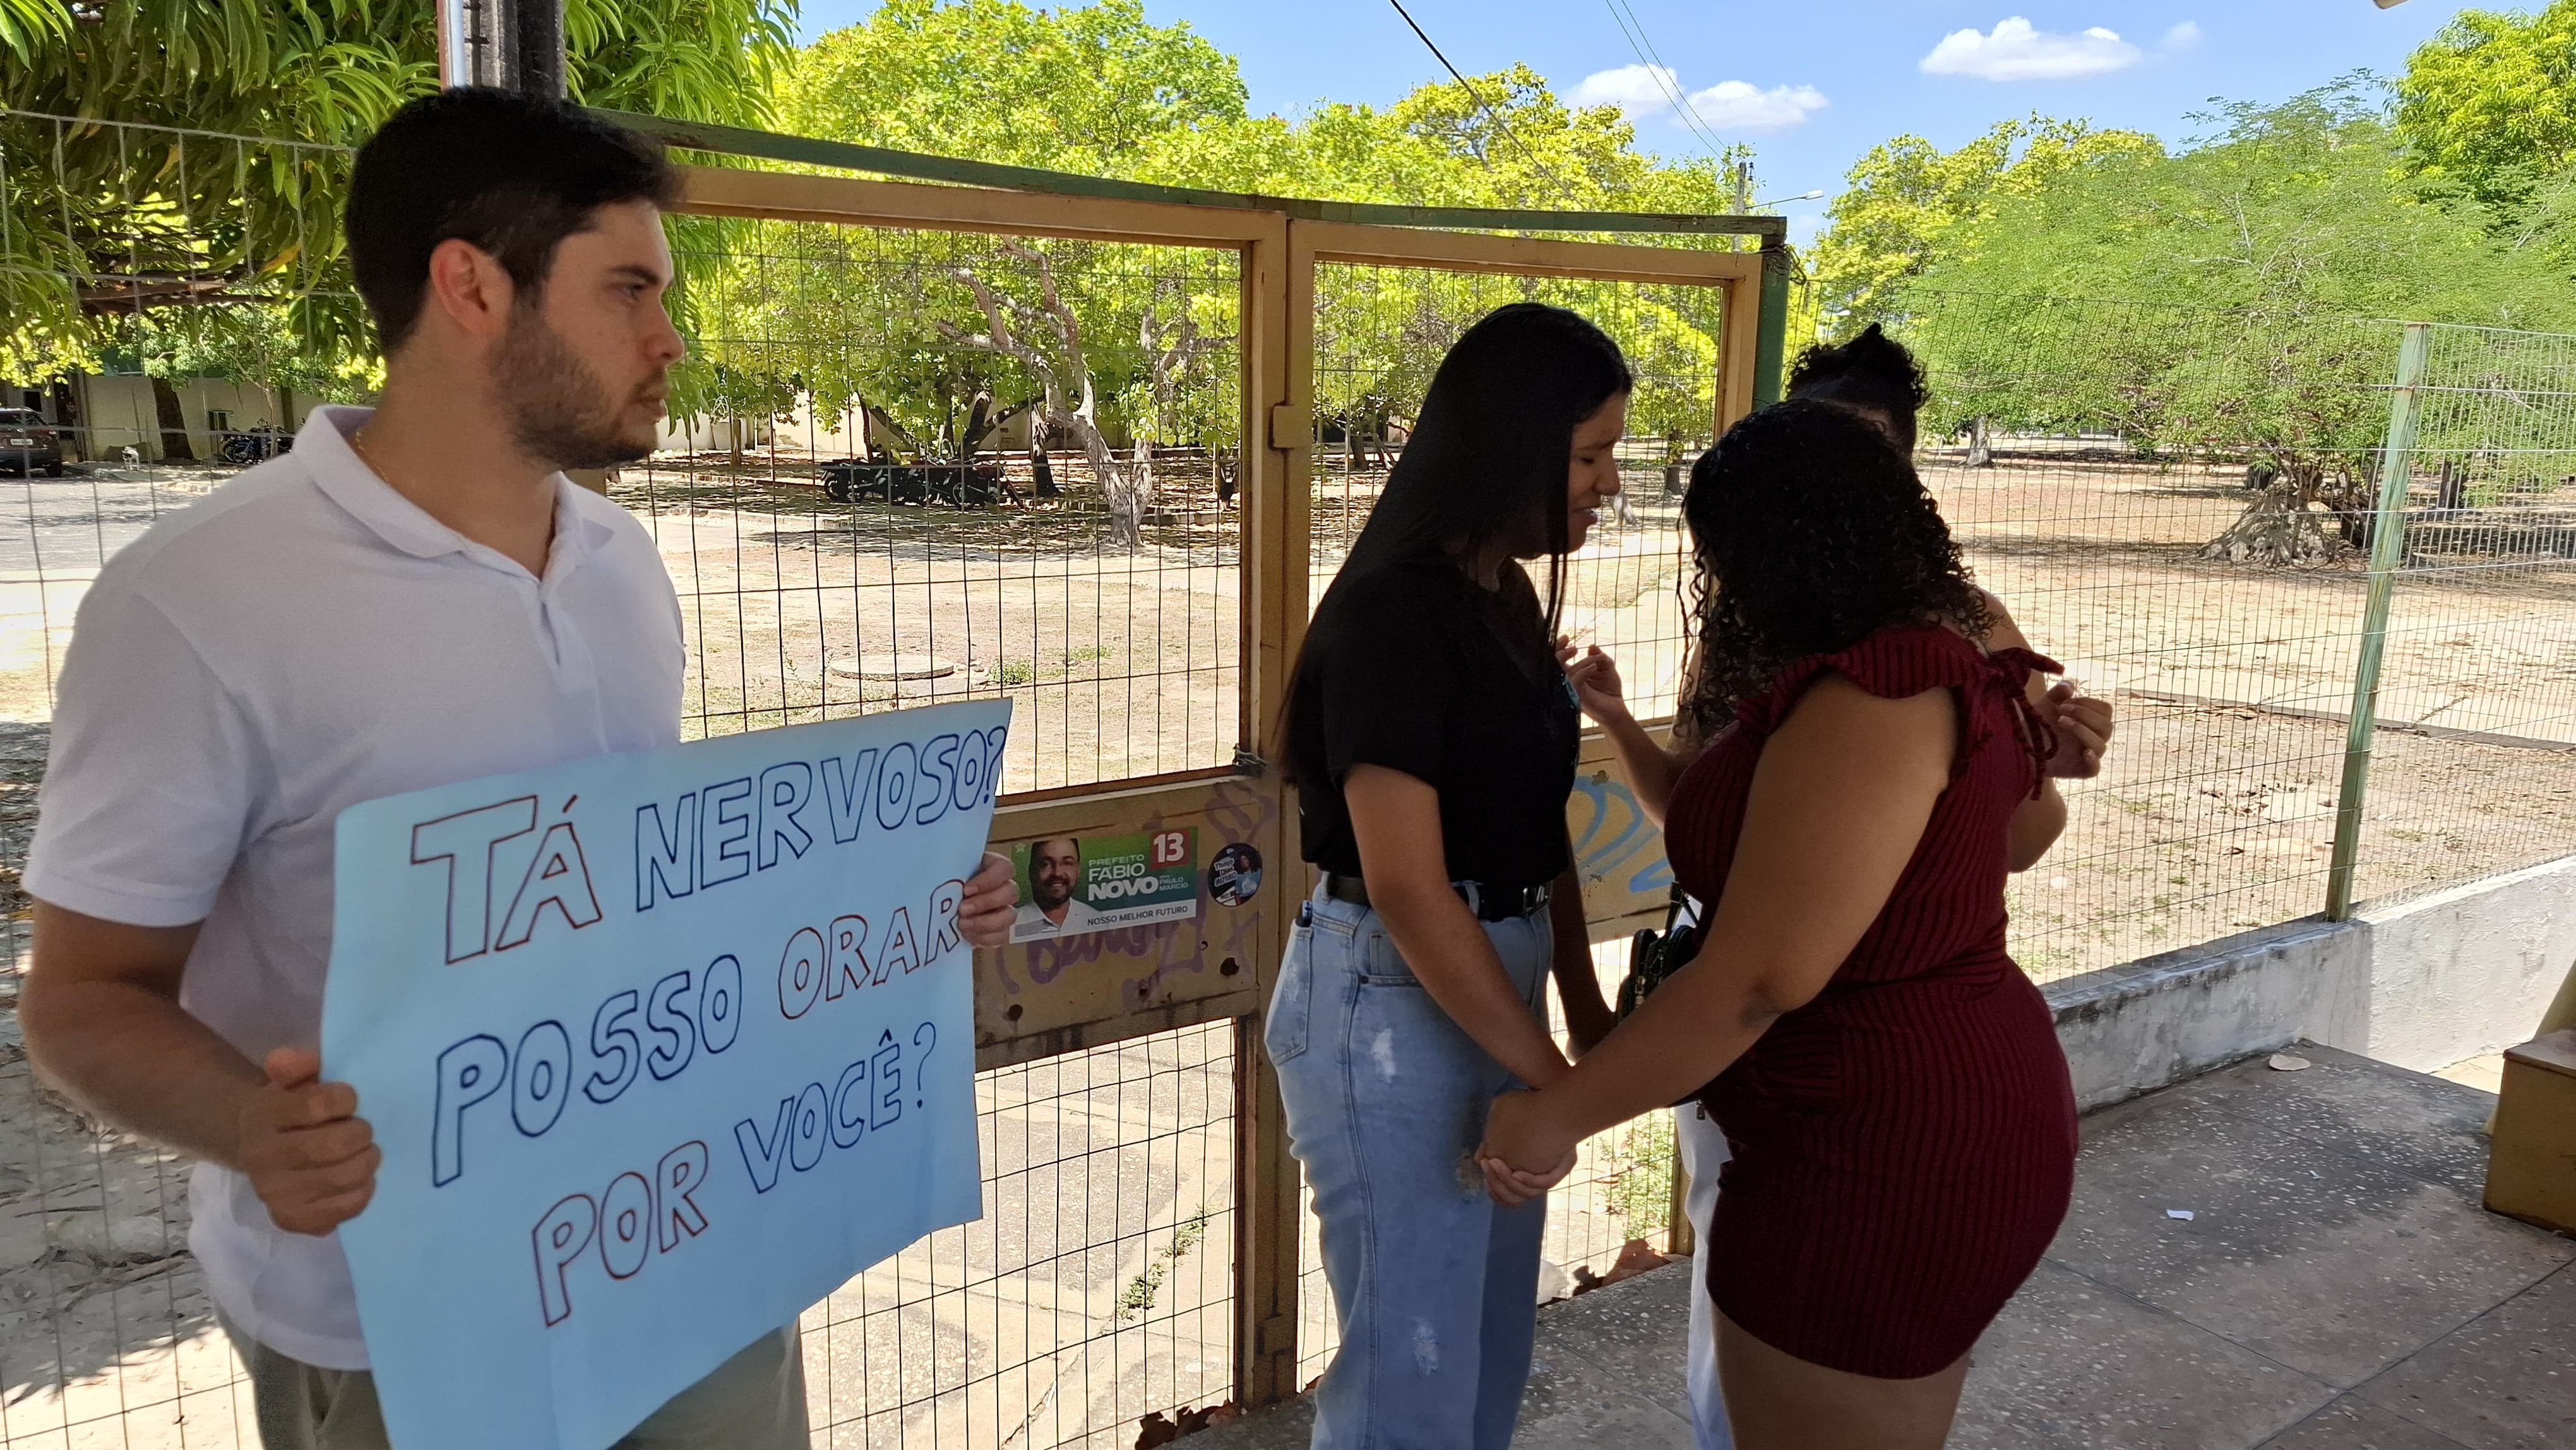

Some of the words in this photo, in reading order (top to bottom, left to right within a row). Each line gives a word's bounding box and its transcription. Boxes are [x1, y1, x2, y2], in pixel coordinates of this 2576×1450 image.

[410, 794, 602, 965] TÁ
[635, 726, 1006, 913] NERVOSO?
[1154, 832, 1184, 863] 13
[1088, 854, 1145, 867] PREFEITO
[1088, 863, 1145, 882] FÁBIO
[1088, 877, 1159, 901] NOVO
[1159, 877, 1184, 885] PAULO
[1087, 915, 1118, 926] NOSSO
[1119, 910, 1154, 922] MELHOR
[1155, 906, 1188, 917] FUTURO
[432, 954, 743, 1187] POSSO
[778, 879, 965, 1020] ORAR
[532, 1140, 709, 1327] POR
[734, 1022, 936, 1194] VOCÊ?
